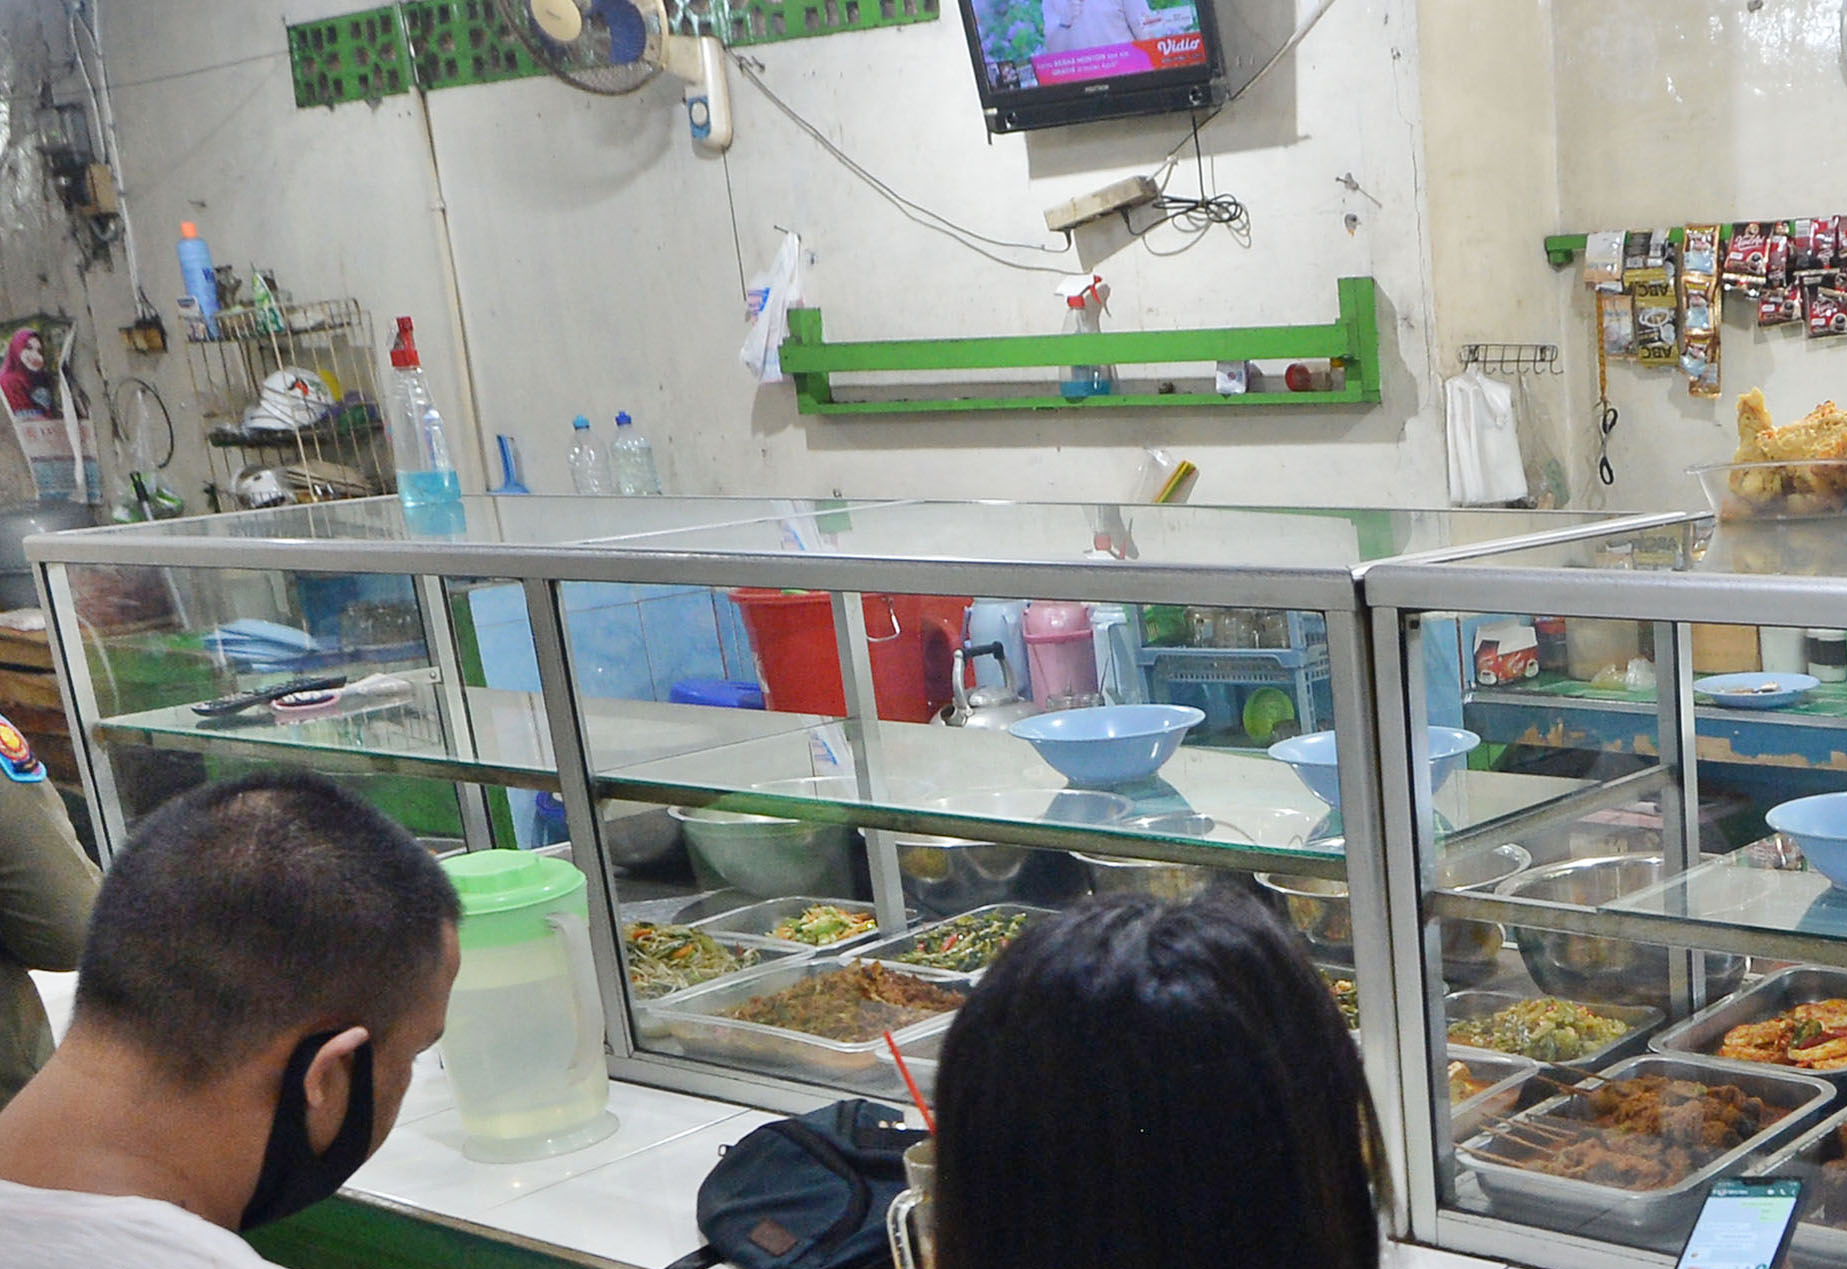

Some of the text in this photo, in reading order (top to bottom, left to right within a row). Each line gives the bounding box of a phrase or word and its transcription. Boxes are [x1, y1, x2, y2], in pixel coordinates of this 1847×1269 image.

[1157, 37, 1201, 56] Vidio
[1639, 284, 1669, 298] ABC
[1641, 346, 1673, 359] ABC
